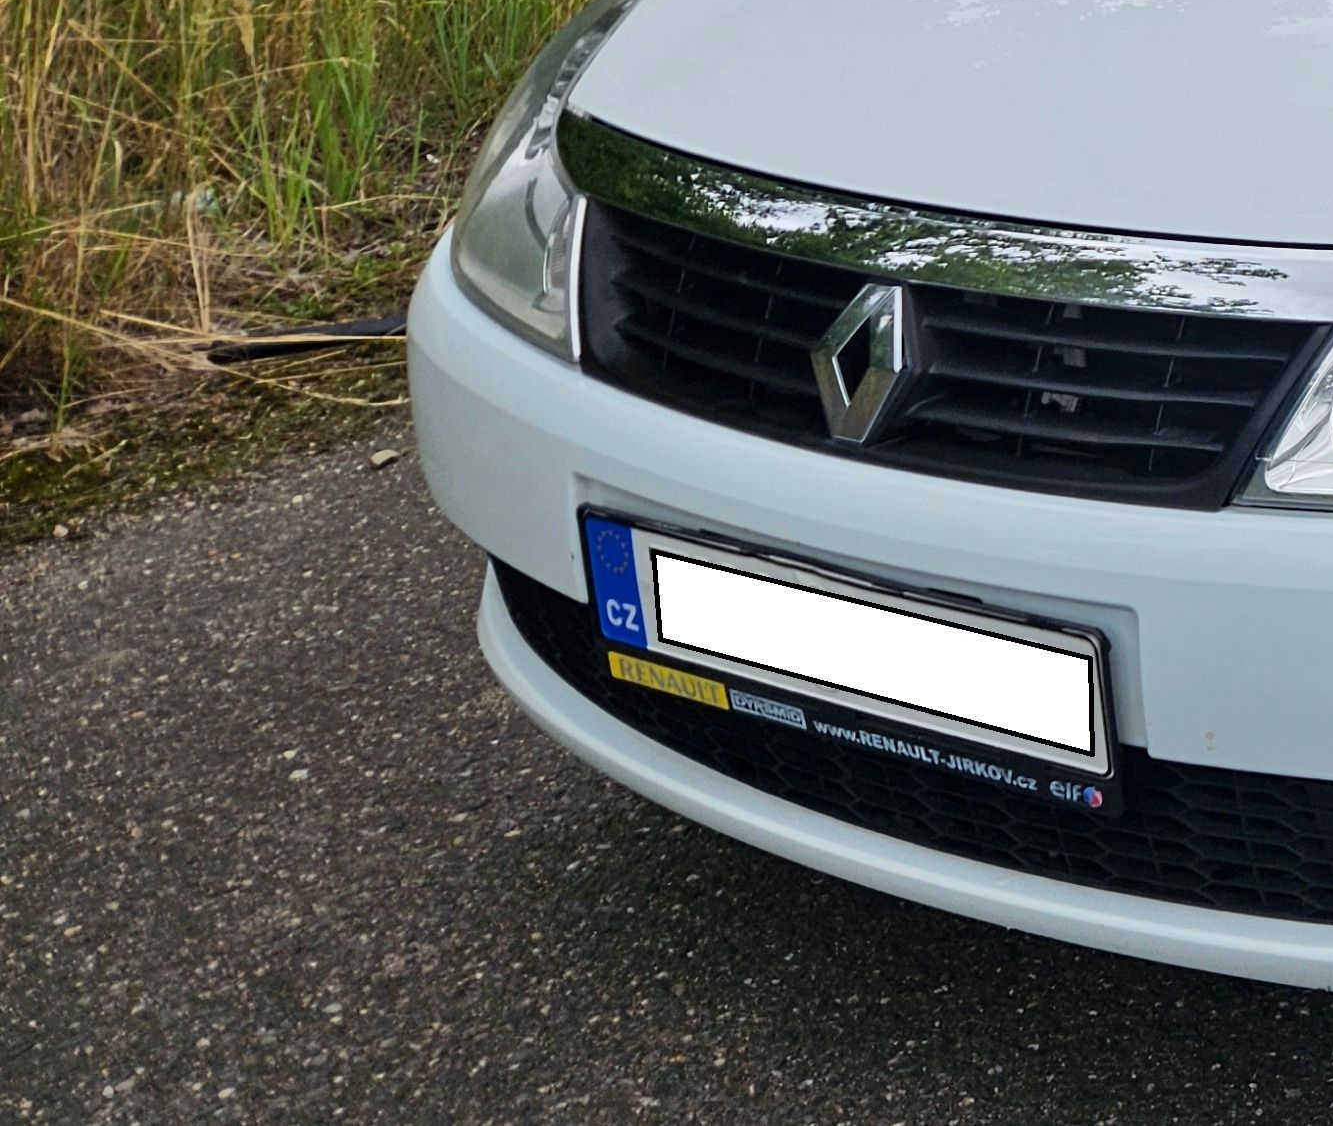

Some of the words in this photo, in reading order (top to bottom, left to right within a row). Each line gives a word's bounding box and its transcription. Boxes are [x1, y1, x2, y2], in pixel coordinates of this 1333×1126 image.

[606, 598, 640, 632] CZ
[617, 657, 721, 707] RENAULT
[812, 719, 1038, 792] www.RENAULT-JIRKOV.cz
[1049, 779, 1083, 803] elf
